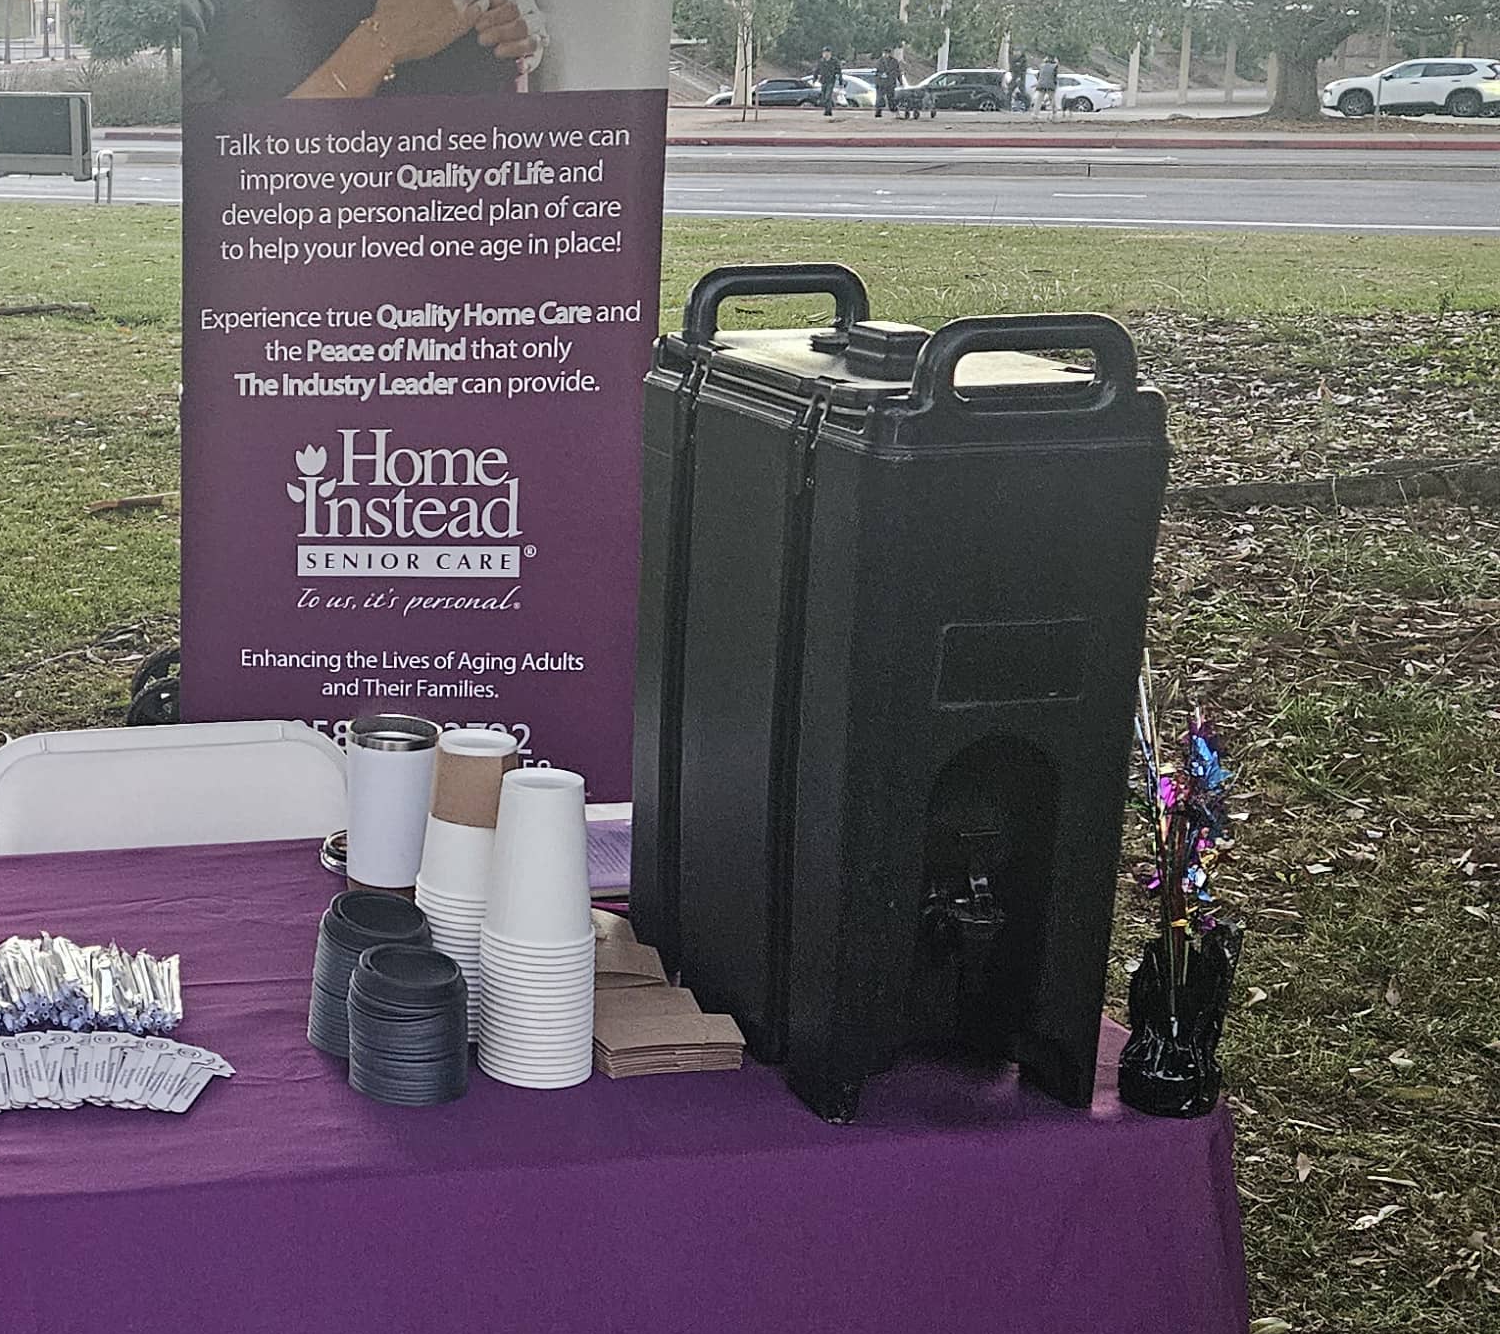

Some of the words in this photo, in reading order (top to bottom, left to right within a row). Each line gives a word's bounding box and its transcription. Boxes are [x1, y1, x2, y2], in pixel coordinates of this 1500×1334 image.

[216, 133, 261, 155] Talk
[266, 135, 289, 154] to
[296, 138, 320, 154] us
[326, 130, 392, 158] today
[398, 128, 441, 151] and
[448, 134, 486, 150] see
[493, 127, 543, 149] how
[549, 131, 583, 147] we
[589, 130, 629, 146] can
[241, 170, 334, 195] improve
[340, 171, 392, 194] your
[397, 163, 482, 193] Quality
[484, 161, 511, 186] of
[514, 160, 554, 185] Life
[560, 159, 602, 182] and
[223, 203, 313, 229] develop
[319, 208, 331, 223] a
[338, 199, 482, 229] personalized
[490, 198, 538, 226] plan
[545, 196, 569, 218] of
[573, 201, 621, 217] care
[221, 242, 243, 259] to
[250, 237, 299, 264] help
[304, 243, 356, 264] your
[362, 235, 423, 257] loved
[430, 241, 474, 256] one
[480, 239, 522, 261] age
[529, 234, 548, 254] in
[555, 231, 620, 259] place!
[202, 307, 321, 333] Experience
[326, 308, 372, 327] true
[377, 303, 460, 332] Quality
[464, 303, 535, 326] Home
[539, 302, 592, 324] Care
[596, 300, 640, 321] and
[265, 340, 302, 361] the
[307, 340, 374, 361] Peace
[378, 338, 405, 361] of
[407, 337, 466, 360] Mind
[471, 338, 517, 359] that
[523, 336, 572, 363] only
[234, 373, 278, 396] The
[283, 373, 376, 401] Industry
[379, 372, 458, 395] Leader
[462, 378, 501, 393] can
[509, 370, 599, 398] provide.
[337, 429, 508, 486] Home
[297, 475, 523, 539] Instead
[307, 553, 418, 569] SENIOR
[298, 589, 319, 607] To
[326, 597, 356, 609] us,
[364, 588, 399, 608] it's
[242, 649, 340, 672] Enhancing
[346, 651, 377, 668] the
[383, 651, 429, 668] Lives
[434, 651, 455, 669] of
[458, 653, 516, 674] Aging
[521, 652, 583, 670] Adults
[322, 678, 358, 695] and
[363, 679, 412, 696] Their
[417, 680, 498, 698] Families.
